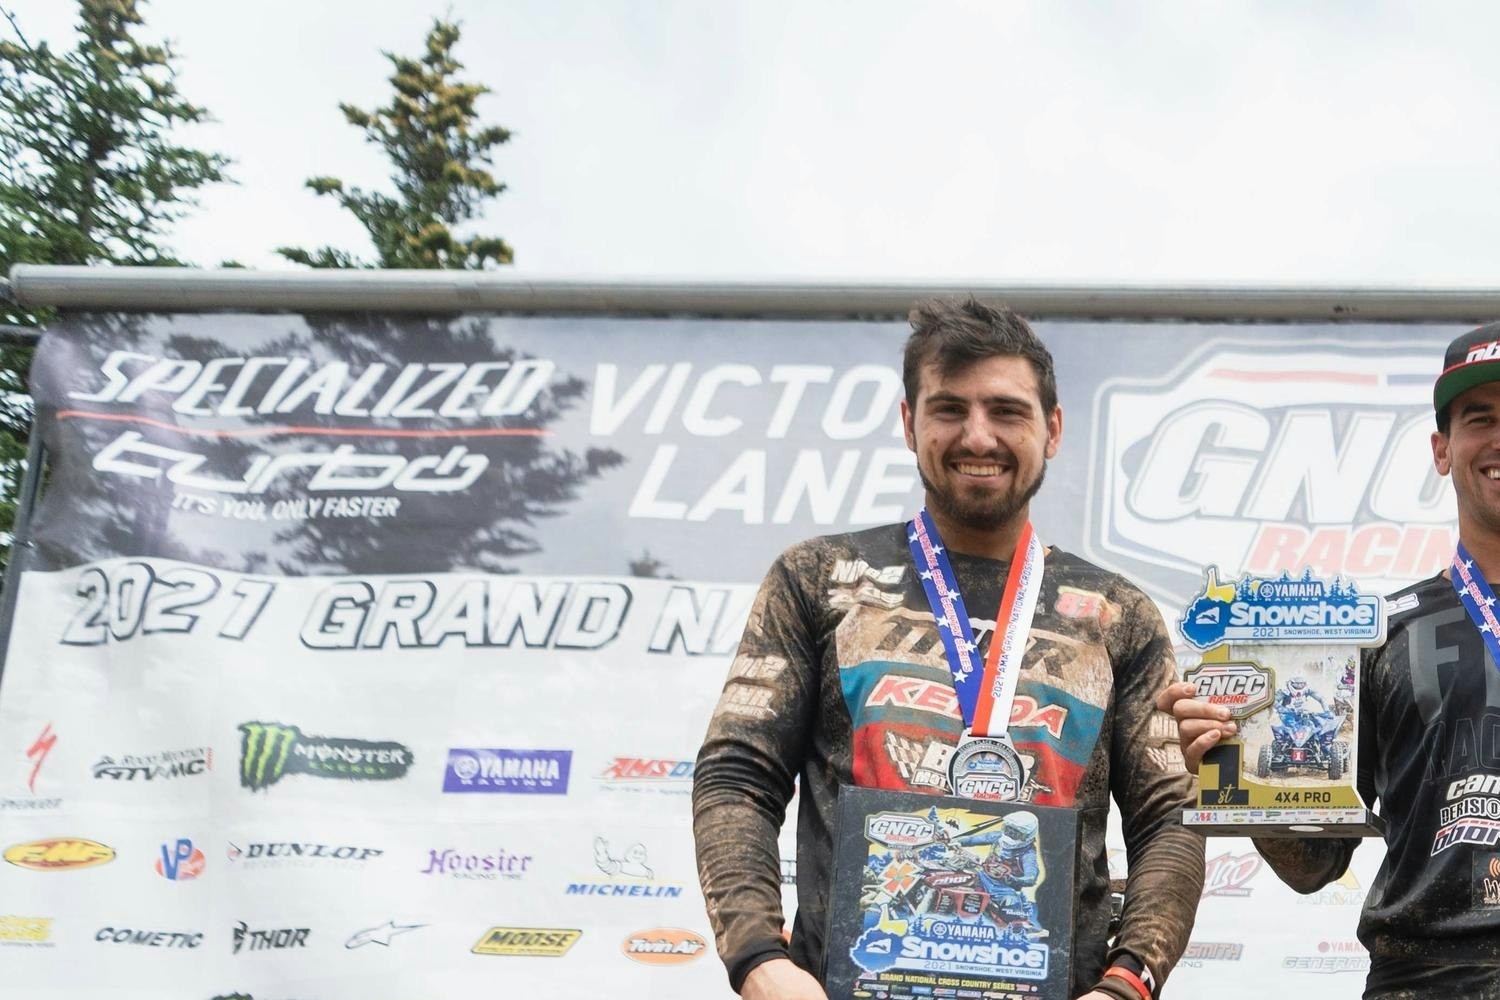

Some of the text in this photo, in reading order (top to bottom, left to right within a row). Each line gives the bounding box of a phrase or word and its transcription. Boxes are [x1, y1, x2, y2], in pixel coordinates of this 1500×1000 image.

[66, 350, 556, 418] SPECIALIZED
[589, 362, 904, 439] VICTO
[92, 430, 489, 493] turbo
[627, 444, 916, 525] LANE
[271, 494, 323, 520] ONLY
[323, 494, 402, 519] FASTER
[1249, 525, 1458, 576] RACIN
[1274, 583, 1322, 597] YAMAHA
[59, 560, 276, 647] 2021
[300, 579, 633, 650] GRAND
[1229, 601, 1373, 627] Snowshoe
[1252, 627, 1280, 637] 2021
[954, 638, 974, 673] SERIES
[991, 672, 1006, 699] 2021
[1194, 674, 1265, 697] GNCC
[864, 674, 1069, 740] KEDA
[1208, 695, 1249, 704] RACING
[478, 759, 561, 781] YAMAHA
[959, 780, 1015, 795] GNCC
[1274, 791, 1331, 803] 4X4 PRO
[872, 821, 933, 838] GNCC
[161, 838, 194, 881] VP
[244, 842, 384, 861] DUNLOP
[565, 883, 684, 898] MICHELIN
[94, 926, 205, 949] COMETIC
[248, 927, 311, 951] THOR
[485, 929, 573, 948] MOOSE
[946, 926, 995, 940] YAMAHA
[901, 936, 1044, 968] Snowshoe
[1331, 941, 1366, 952] YAMA
[879, 973, 1017, 991] GRAND NATIONAL CROSS COUNTRY SERIES
